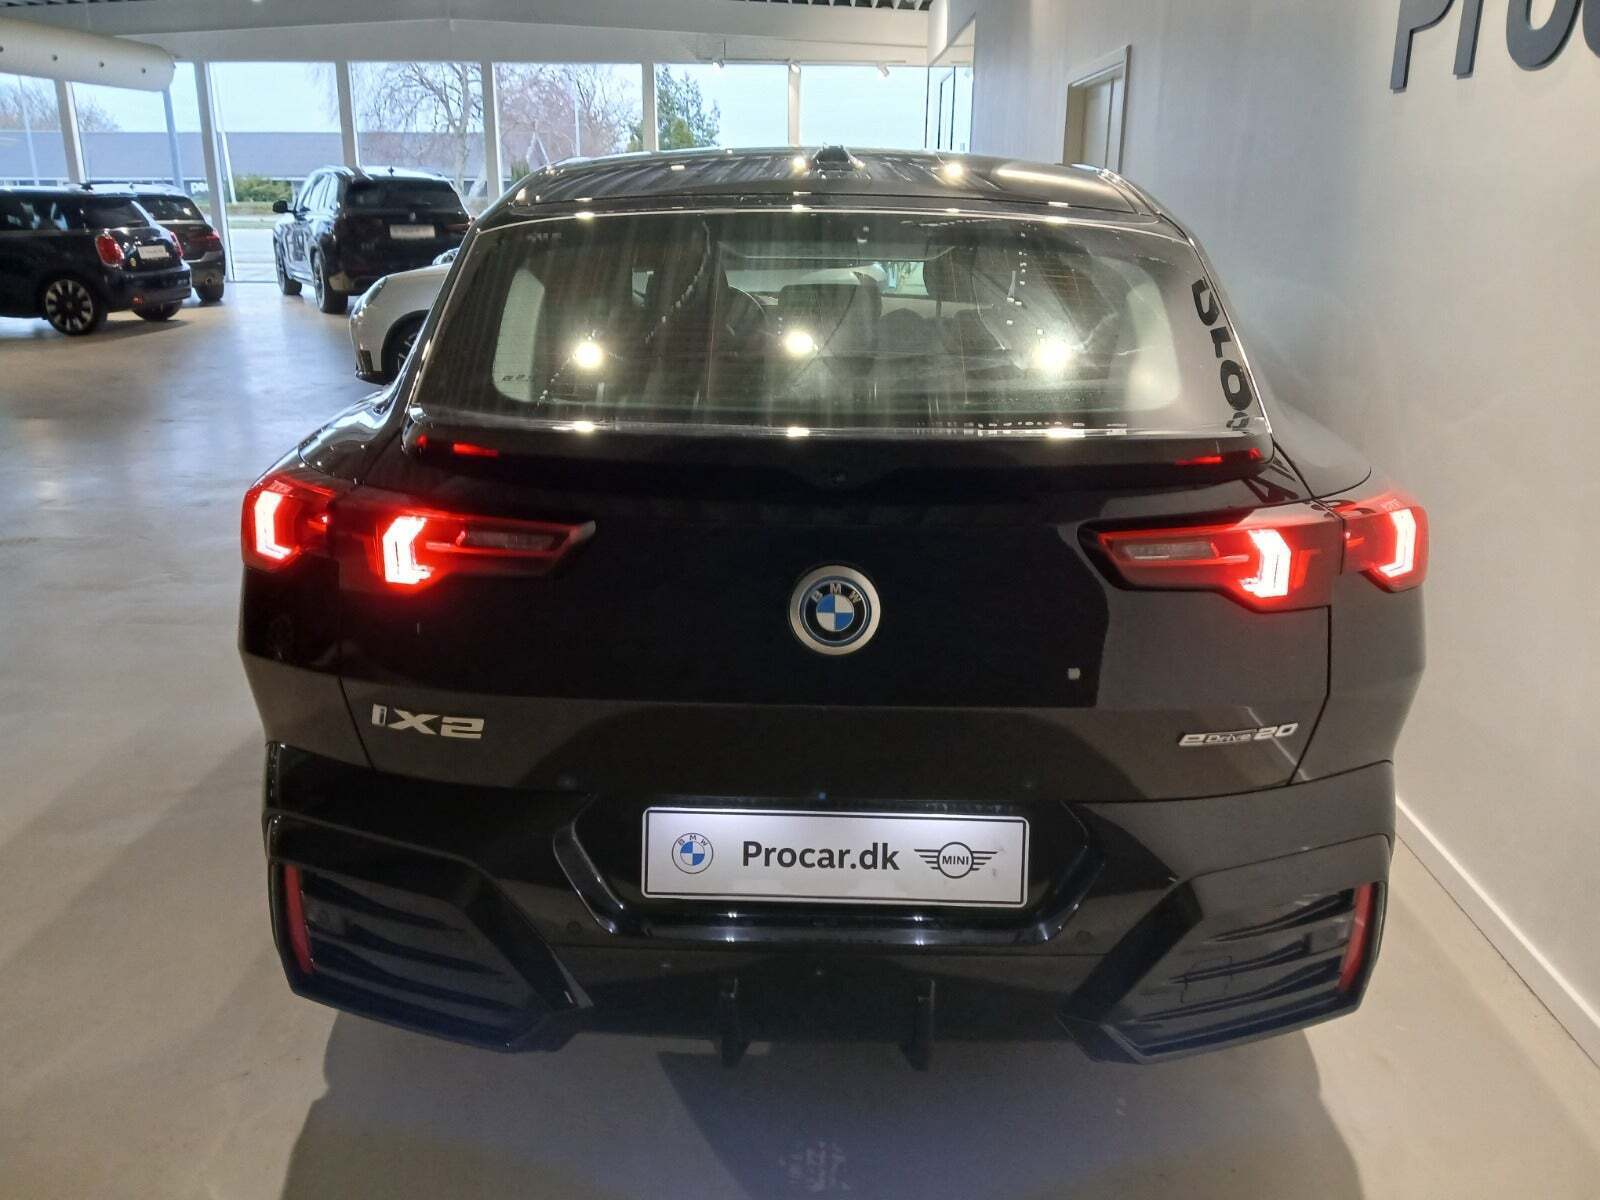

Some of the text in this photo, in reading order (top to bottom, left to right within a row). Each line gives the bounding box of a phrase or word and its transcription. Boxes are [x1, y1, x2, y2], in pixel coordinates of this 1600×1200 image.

[1390, 0, 1600, 92] Pro
[810, 583, 862, 604] BMW
[371, 703, 485, 739] iX2
[677, 834, 709, 846] BMW
[742, 840, 900, 871] Procar.dk
[942, 855, 970, 866] MINI
